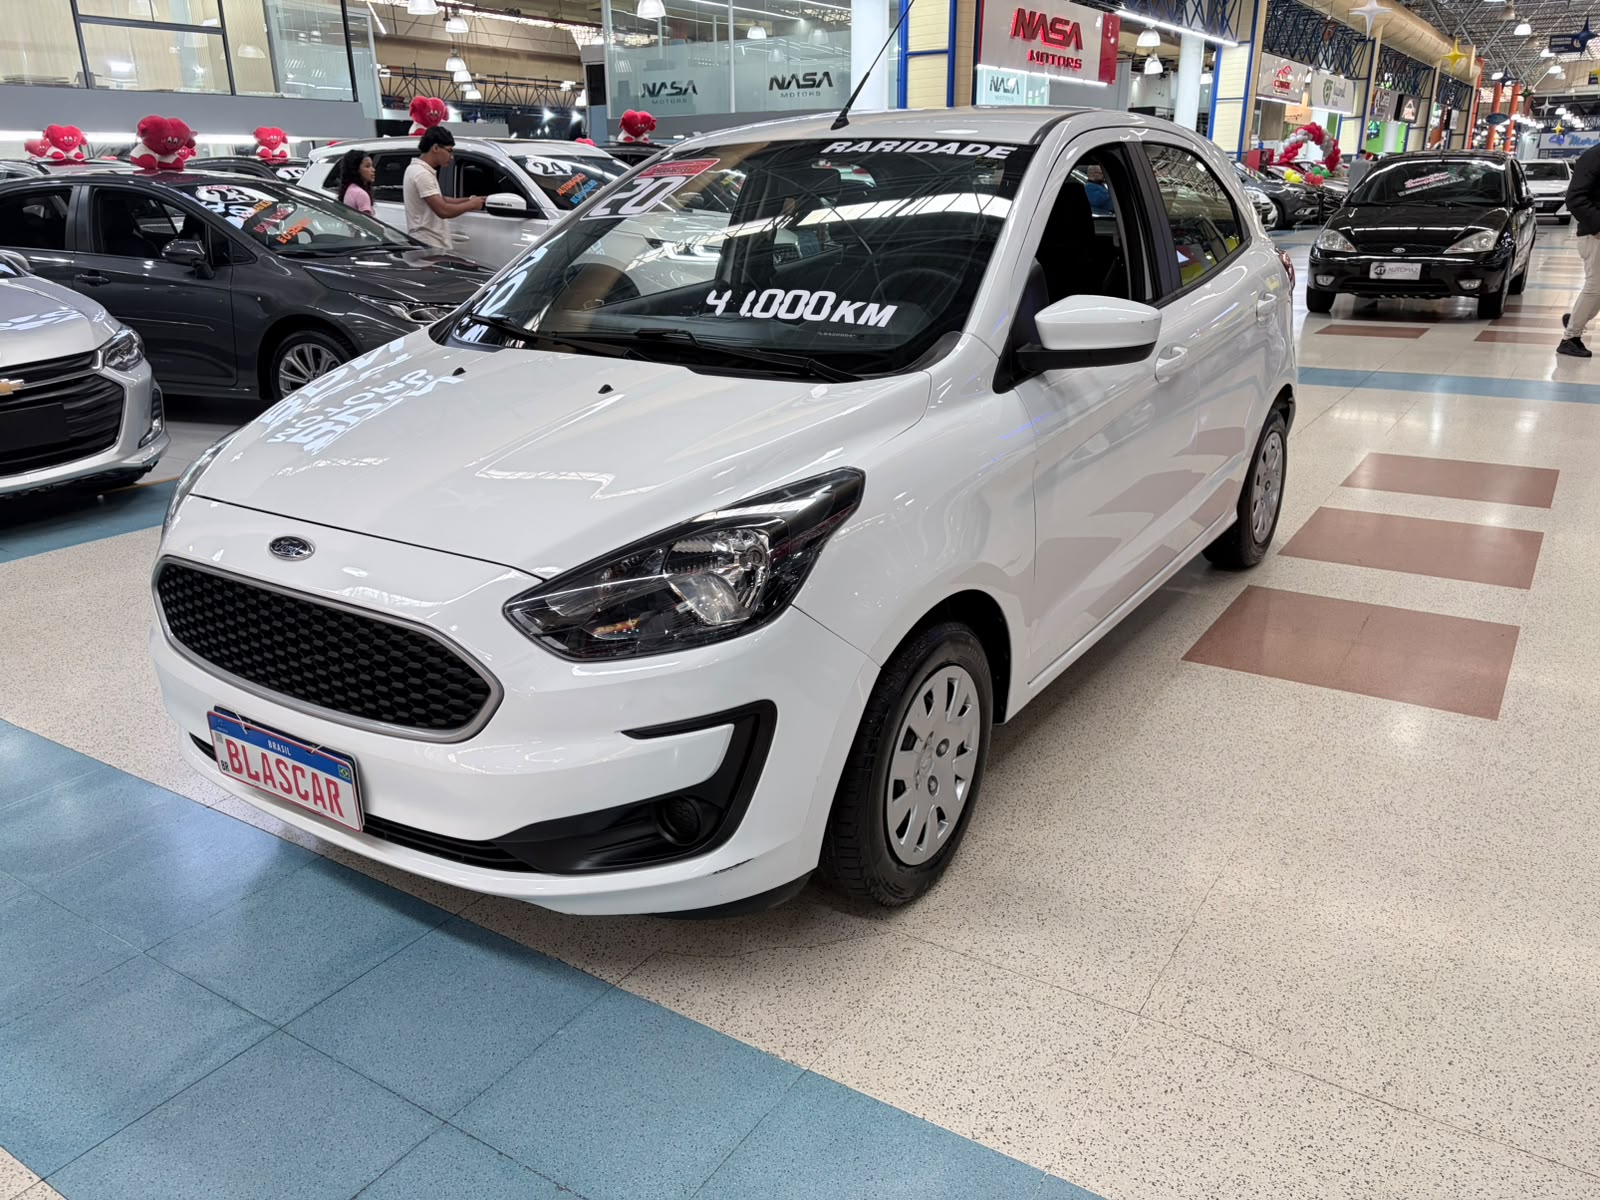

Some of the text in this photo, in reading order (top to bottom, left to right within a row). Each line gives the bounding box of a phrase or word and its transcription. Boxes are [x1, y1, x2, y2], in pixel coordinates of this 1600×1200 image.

[1010, 7, 1083, 50] NASA
[1027, 49, 1082, 71] MOTORS
[641, 80, 698, 98] NASA
[769, 71, 833, 91] NASA
[989, 75, 1020, 95] NASA
[780, 90, 821, 98] MOTORS
[820, 140, 1018, 160] RARIDADE
[533, 162, 570, 175] 24
[588, 176, 687, 216] 20
[267, 739, 292, 756] BRASIL
[220, 759, 230, 772] BR
[224, 738, 345, 819] BLASCAR
